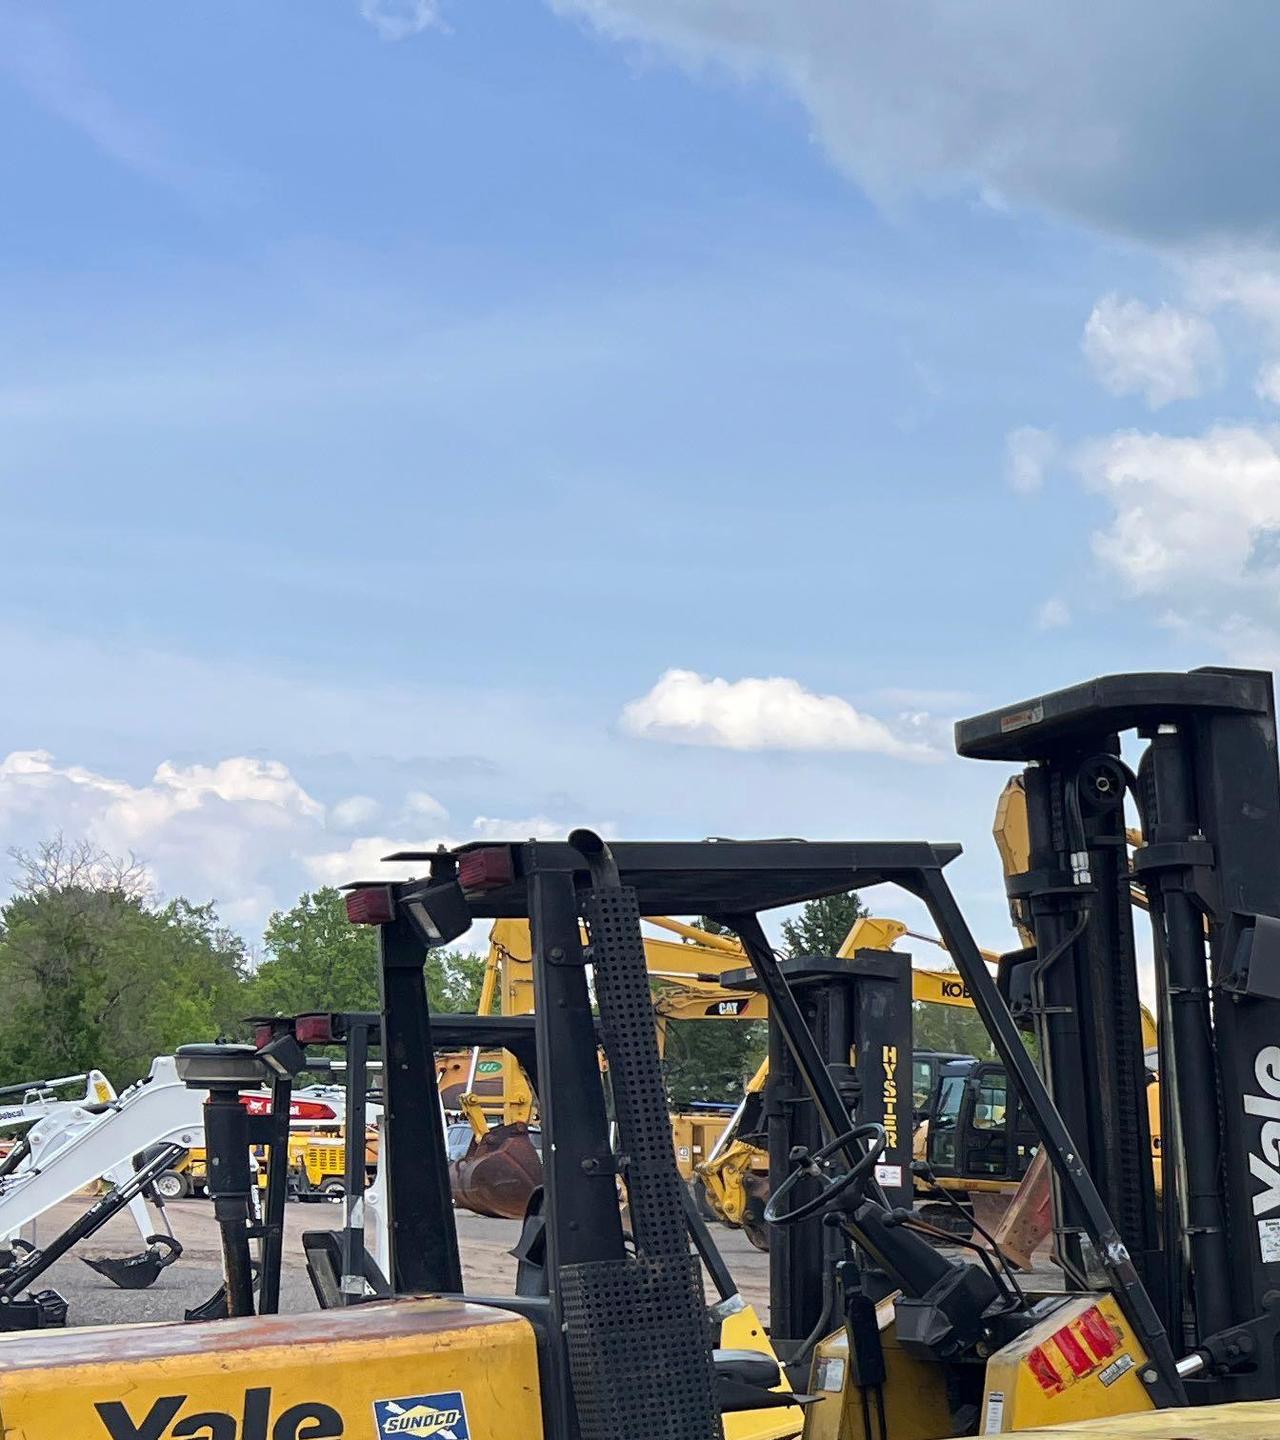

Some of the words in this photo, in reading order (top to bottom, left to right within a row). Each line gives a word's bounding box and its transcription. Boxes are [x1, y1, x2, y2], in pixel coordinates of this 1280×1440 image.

[718, 1002, 738, 1015] CAT
[882, 1045, 897, 1149] HYSTER
[387, 1411, 457, 1432] SUNOCO
